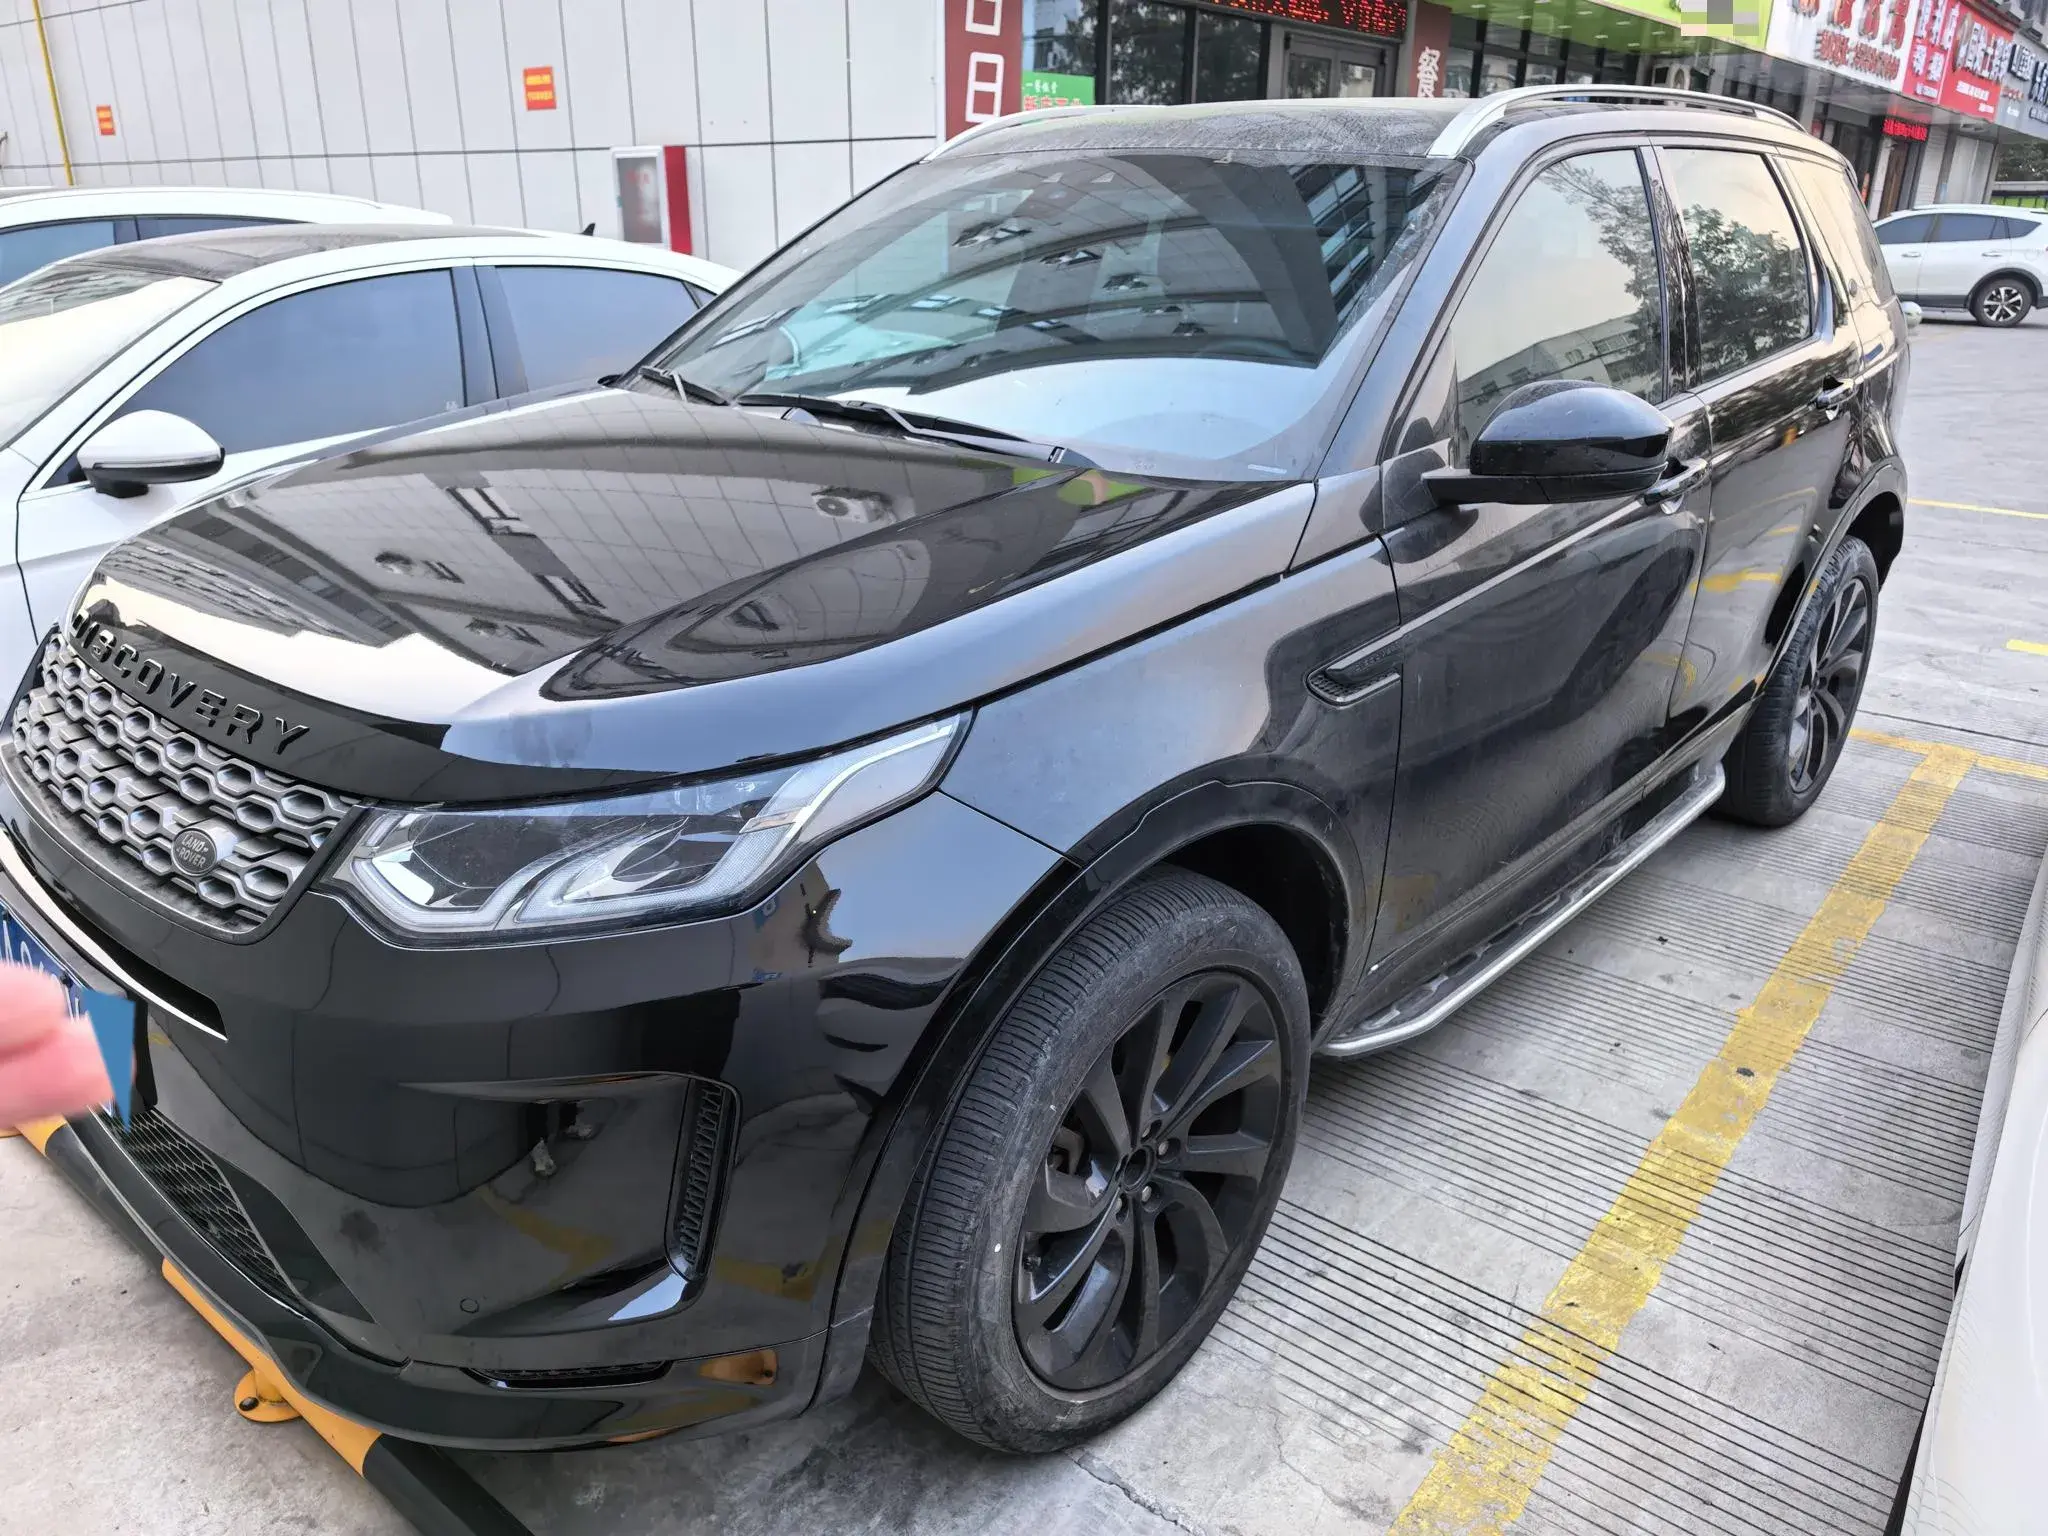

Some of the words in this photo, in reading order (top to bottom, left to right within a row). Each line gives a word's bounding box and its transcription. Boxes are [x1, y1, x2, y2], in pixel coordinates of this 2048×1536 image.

[71, 609, 310, 755] DISCOVERY
[181, 834, 206, 852] LAND
[178, 847, 206, 868] ROVER
